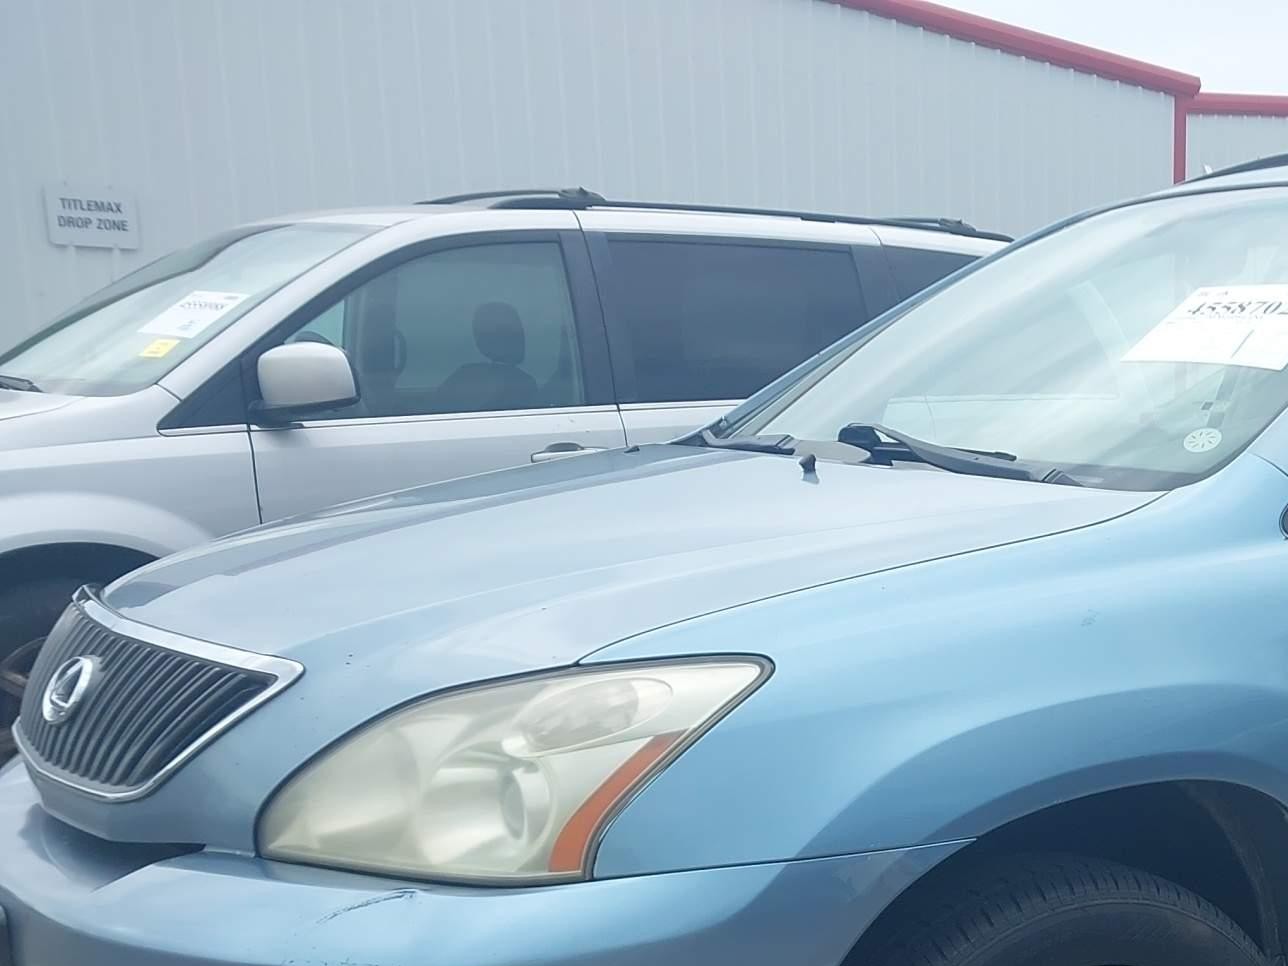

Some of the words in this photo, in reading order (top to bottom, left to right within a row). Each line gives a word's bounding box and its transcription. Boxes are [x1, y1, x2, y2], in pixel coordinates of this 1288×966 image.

[59, 197, 123, 214] TITLEMAX
[57, 215, 93, 229] DROP
[96, 218, 129, 232] ZONE
